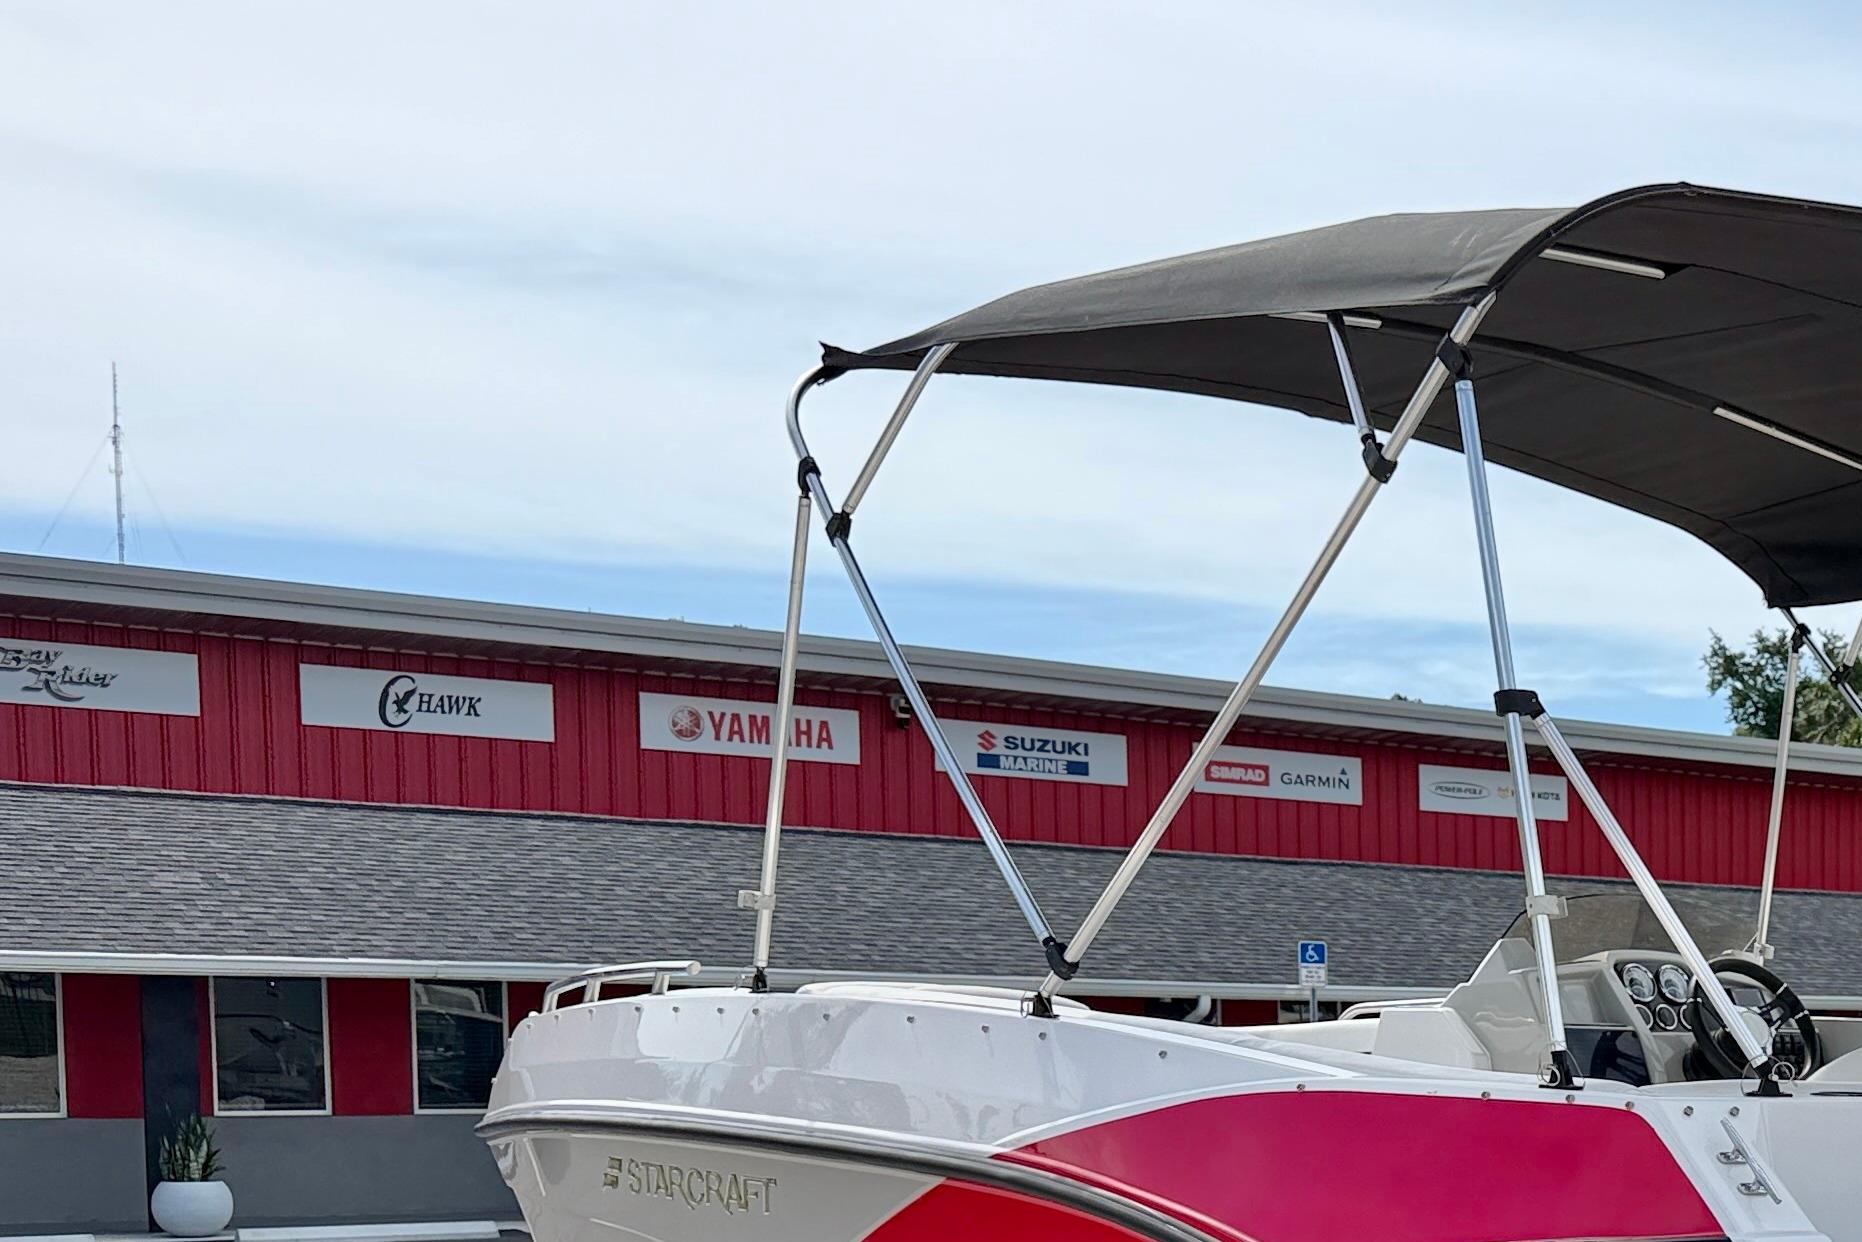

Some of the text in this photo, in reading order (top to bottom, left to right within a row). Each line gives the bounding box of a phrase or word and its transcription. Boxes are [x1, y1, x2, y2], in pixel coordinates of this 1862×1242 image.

[22, 666, 118, 702] Rider
[416, 692, 482, 717] HAWK
[707, 711, 834, 750] YAMHA
[1003, 735, 1089, 756] SUZUKI
[1000, 754, 1068, 775] MARINE
[1210, 765, 1265, 782] SIMRAD
[1281, 772, 1350, 790] GARMIN
[627, 1158, 777, 1215] STARCRAFT
